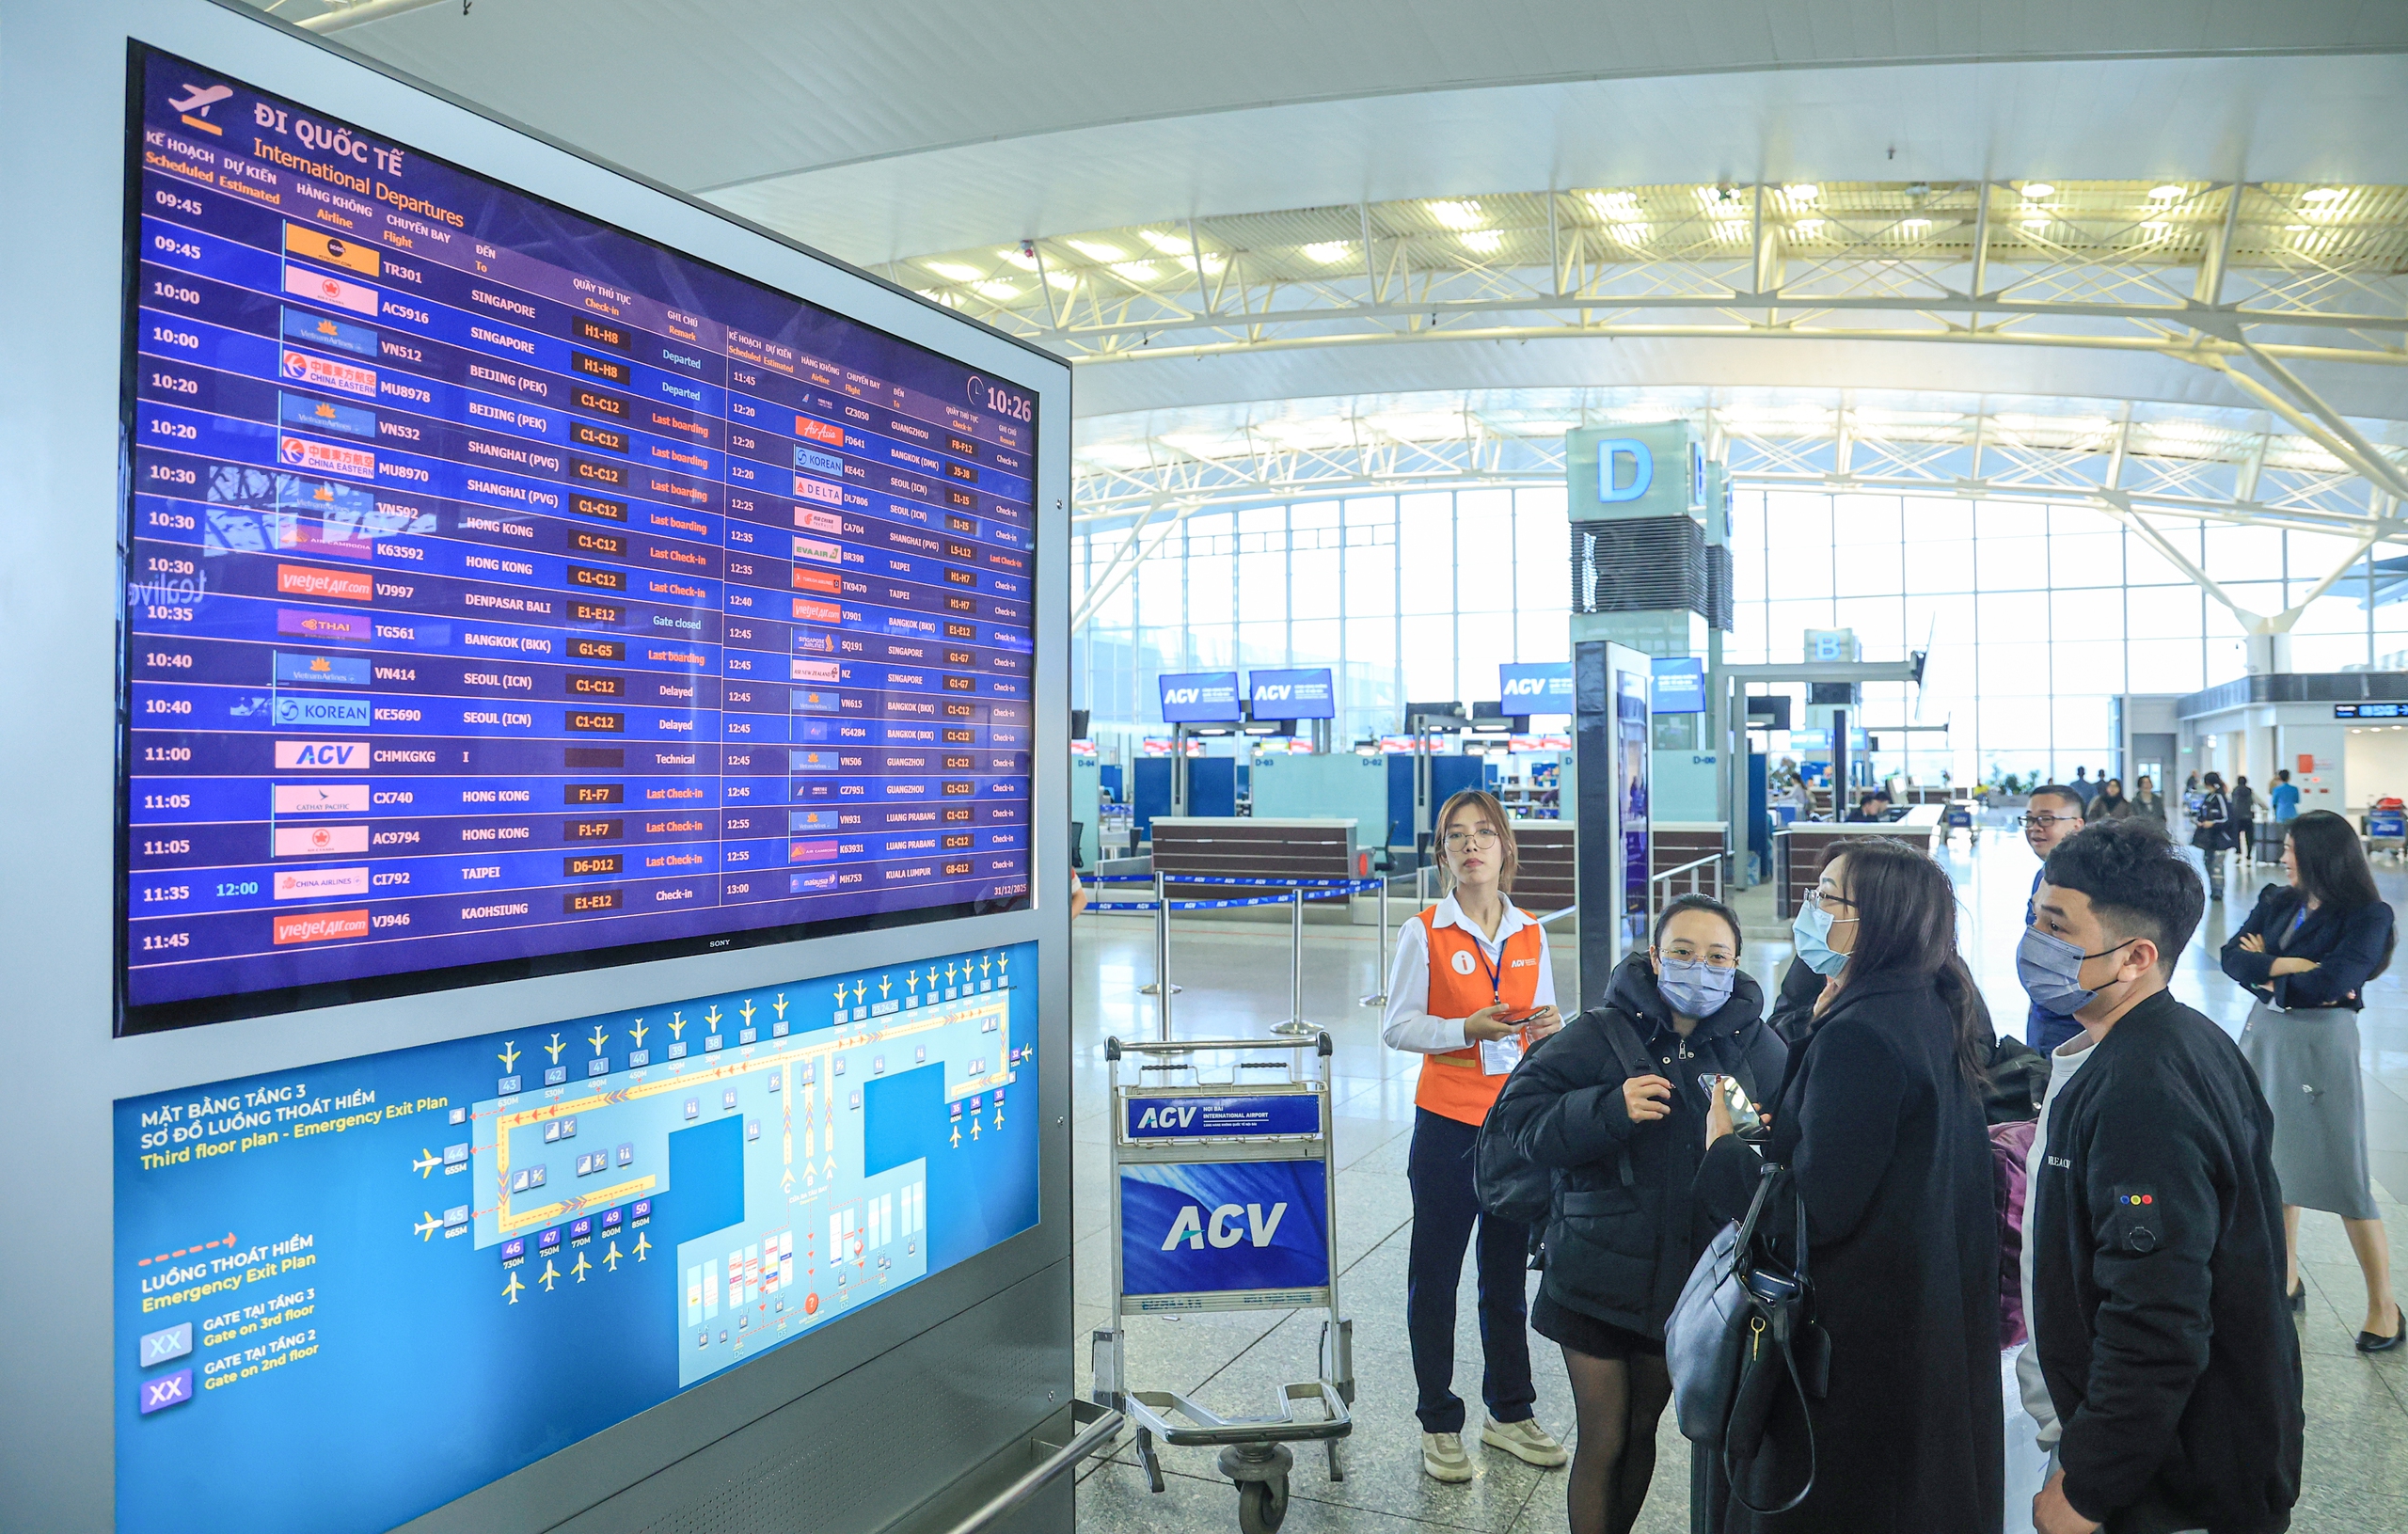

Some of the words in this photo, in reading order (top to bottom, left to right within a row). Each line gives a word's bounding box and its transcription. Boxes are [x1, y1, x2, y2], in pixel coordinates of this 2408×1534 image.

[147, 131, 165, 146] KẾ
[167, 138, 214, 164] HOẠCH
[254, 103, 287, 134] ĐI
[295, 120, 367, 163] QUỐC
[373, 148, 404, 177] TẾ
[145, 150, 214, 182] Scheduled
[219, 175, 280, 205] Estimated
[224, 158, 245, 175] DỰ
[246, 166, 277, 184] KIẾN
[254, 137, 371, 195] International
[376, 182, 465, 228] Departures
[156, 191, 201, 214] 09:45
[297, 183, 329, 202] HÀNG
[333, 194, 372, 217] KHÔNG
[317, 209, 353, 229] Airline
[387, 214, 428, 236] CHUYẾN
[431, 229, 451, 243] BAY
[384, 230, 412, 248] Flight
[476, 245, 495, 259] ĐẾN
[384, 261, 421, 283] TR301
[476, 261, 487, 272] To
[574, 278, 595, 293] QUẦY
[596, 284, 615, 299] THỦ
[616, 293, 631, 305] TỤC
[472, 290, 535, 318] SINGAPORE
[585, 298, 619, 315] Check-in
[668, 310, 681, 322] GHI
[683, 316, 698, 327] CHÚ
[154, 327, 198, 348] 10:00
[586, 324, 618, 343] H1-H8
[670, 325, 695, 340] Remark
[663, 350, 701, 369] Departed
[309, 372, 336, 387] CHINA
[338, 378, 376, 395] EASTERN
[734, 372, 755, 386] 11:45
[381, 381, 430, 403] MU8978
[988, 387, 1031, 421] 10:26
[469, 403, 515, 422] BEIJING
[518, 414, 546, 432] (PEK)
[846, 407, 869, 420] CZ3050
[892, 421, 928, 439] GUANGZHOU
[652, 446, 670, 459] Last
[672, 451, 708, 469] boarding
[891, 449, 920, 467] BANGKOK
[921, 458, 939, 471] (DMK)
[997, 455, 1018, 467] Check-in
[1599, 437, 1654, 503] D
[808, 484, 839, 499] DELTA
[149, 558, 194, 574] 10:30
[376, 584, 413, 597] VJ997
[466, 594, 524, 610] DENPASAR
[527, 601, 550, 613] BALI
[654, 616, 673, 626] Gate
[675, 618, 701, 629] closed
[842, 641, 863, 652] SQ191
[888, 646, 923, 657] SINGAPORE
[1815, 631, 1842, 661] B
[950, 653, 968, 662] G1-G7
[1255, 685, 1291, 700] ACV
[1504, 679, 1545, 694] ACV
[1164, 688, 1200, 705] ACV
[147, 700, 191, 713] 10:40
[306, 705, 366, 719] KOREAN
[375, 709, 420, 720] KE5690
[464, 712, 499, 723] SEOUL
[502, 713, 531, 727] (ICN)
[659, 720, 692, 732] Delayed
[146, 748, 190, 760] 11:00
[296, 746, 354, 765] ACV
[374, 751, 436, 762] CHMKGKG
[656, 754, 694, 764] Technical
[462, 867, 499, 879] TAIPEI
[574, 860, 613, 872] D6-D12
[886, 869, 905, 879] KUALA
[907, 868, 931, 877] LUMPUR
[373, 873, 409, 885] CI792
[840, 874, 862, 883] MH753
[144, 886, 189, 901] 11:35
[217, 882, 258, 896] 12:00
[994, 884, 1026, 895] 31/12/2025
[462, 904, 528, 919] KAOHSIUNG
[372, 914, 410, 927] VJ946
[144, 933, 189, 950] 11:45
[1511, 959, 1525, 968] ACV
[873, 1003, 897, 1014] 23,24,25
[775, 1023, 786, 1034] 36
[502, 1080, 517, 1091] 43
[141, 1105, 183, 1128] MẶT
[189, 1097, 241, 1118] BẰNG
[245, 1087, 293, 1107] TẦNG
[296, 1084, 307, 1098] 3
[498, 1097, 519, 1107] 630M
[972, 1098, 980, 1106] 34
[141, 1129, 168, 1149] SƠ
[172, 1119, 202, 1142] ĐỒ
[209, 1111, 271, 1136] LUỒNG
[278, 1098, 331, 1123] THOÁT
[336, 1089, 375, 1110] HIỂM
[1137, 1106, 1197, 1129] ACV
[141, 1147, 189, 1169] Third
[195, 1140, 236, 1159] floor
[242, 1132, 278, 1152] plan
[293, 1111, 382, 1138] Emergency
[387, 1102, 414, 1118] Exit
[418, 1098, 449, 1113] Plan
[448, 1149, 464, 1161] 44
[445, 1163, 467, 1175] 655M
[631, 1217, 650, 1228] 850M
[1161, 1202, 1288, 1251] ACV
[506, 1242, 520, 1254] 46
[143, 1264, 208, 1293] LUỒNG
[211, 1246, 269, 1273] THOÁT
[273, 1234, 313, 1257] HIỂM
[503, 1257, 524, 1270] 730M
[143, 1273, 242, 1313] Emergency
[246, 1263, 277, 1282] Exit
[281, 1255, 316, 1273] Plan
[204, 1315, 241, 1331] GATE
[244, 1305, 264, 1319] TẠI
[268, 1292, 304, 1311] TẦNG
[306, 1289, 315, 1300] 3
[204, 1330, 237, 1346] Gate
[240, 1324, 257, 1335] on
[261, 1315, 282, 1329] 3rd
[285, 1305, 315, 1321] floor
[150, 1332, 182, 1354] XX
[205, 1356, 242, 1373] GATE
[245, 1347, 265, 1361] TẠI
[269, 1334, 306, 1352] TẦNG
[308, 1329, 316, 1341] 2
[205, 1373, 237, 1389] Gate
[240, 1368, 258, 1377] on
[261, 1356, 286, 1372] 2nd
[289, 1345, 320, 1361] floor
[150, 1377, 182, 1405] XX
